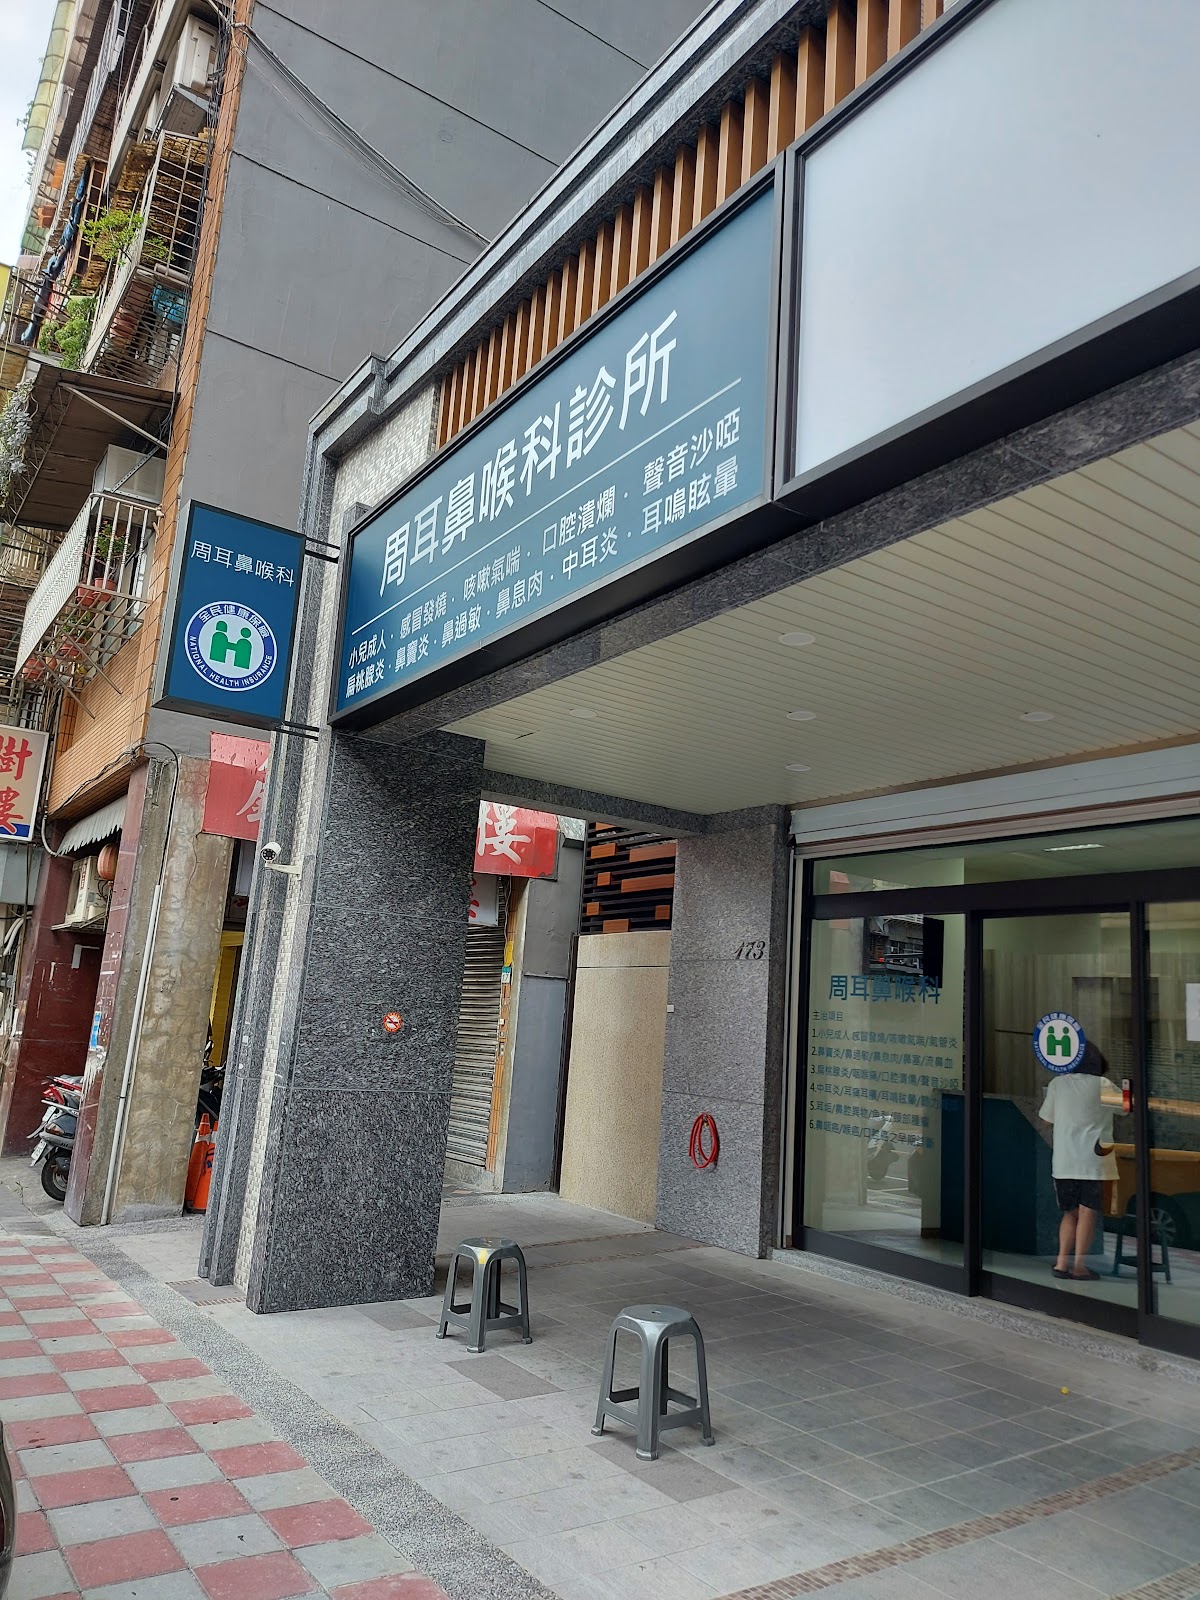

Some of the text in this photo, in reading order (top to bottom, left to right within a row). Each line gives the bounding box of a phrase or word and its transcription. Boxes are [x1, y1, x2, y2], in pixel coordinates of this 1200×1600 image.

[379, 310, 678, 598] 周耳鼻喉科診所
[348, 407, 741, 670] 小兒成人 感冒發燒 咳嗽氣喘 口腔潰爛 聲音沙啞
[191, 540, 295, 588] 周耳鼻喉科
[345, 454, 739, 699] 扁桃腺炎 鼻竇炎 鼻過敏 鼻息肉 中耳炎 耳鳴眩暈
[198, 604, 270, 639] 全民健康保險
[189, 635, 273, 687] NATIONAL HEALTH INSURANCE
[732, 940, 766, 960] 173
[828, 975, 941, 1004] 周耳鼻喉科
